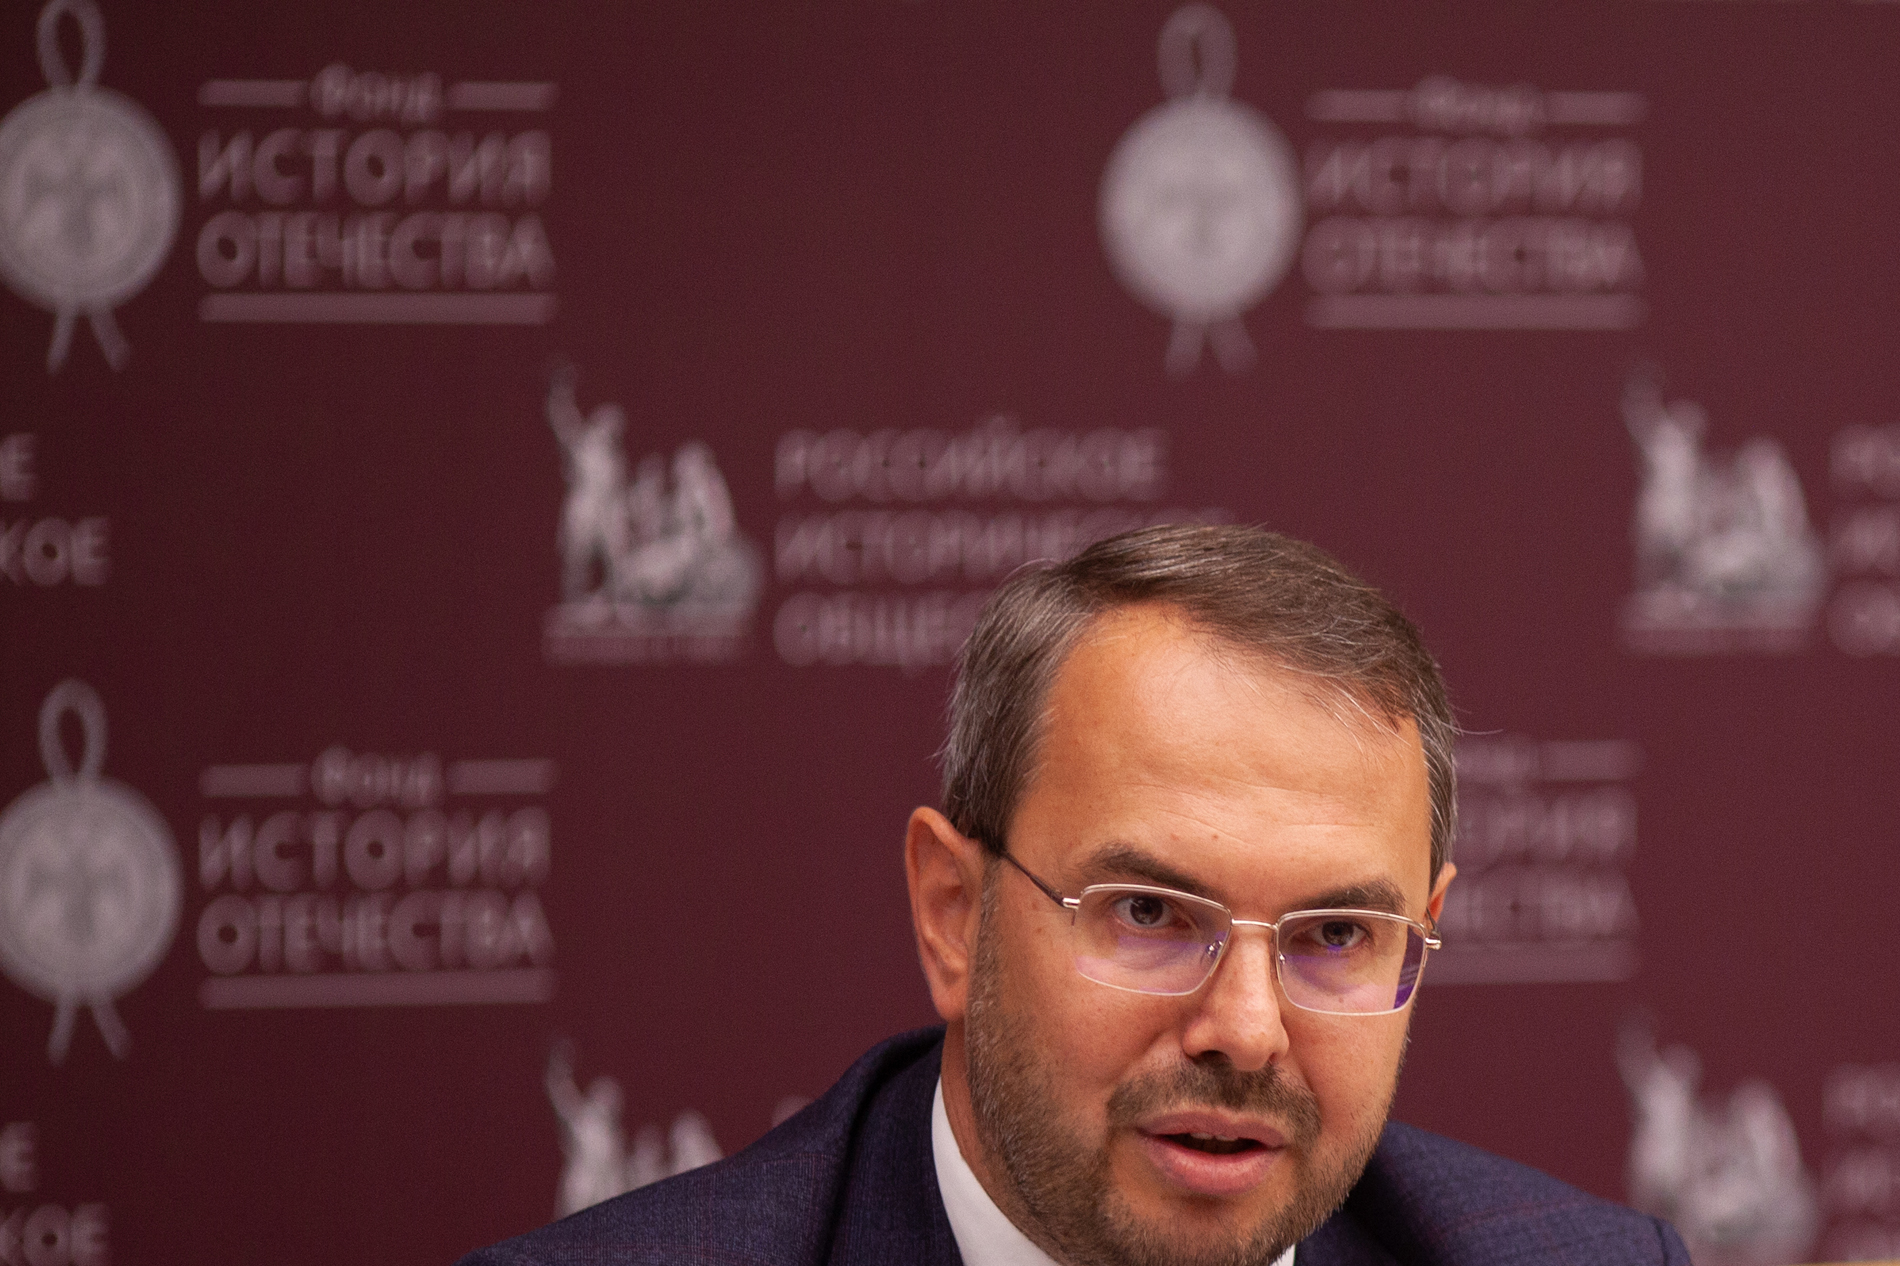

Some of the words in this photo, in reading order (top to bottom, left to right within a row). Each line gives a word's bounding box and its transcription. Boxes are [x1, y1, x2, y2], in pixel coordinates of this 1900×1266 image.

[199, 129, 553, 201] ИСТОРИЯ
[198, 211, 556, 288] ОТЕЧЕСТВА
[199, 808, 553, 890] ИСТОРИЯ
[198, 891, 556, 973] ОТЕЧЕСТВА
